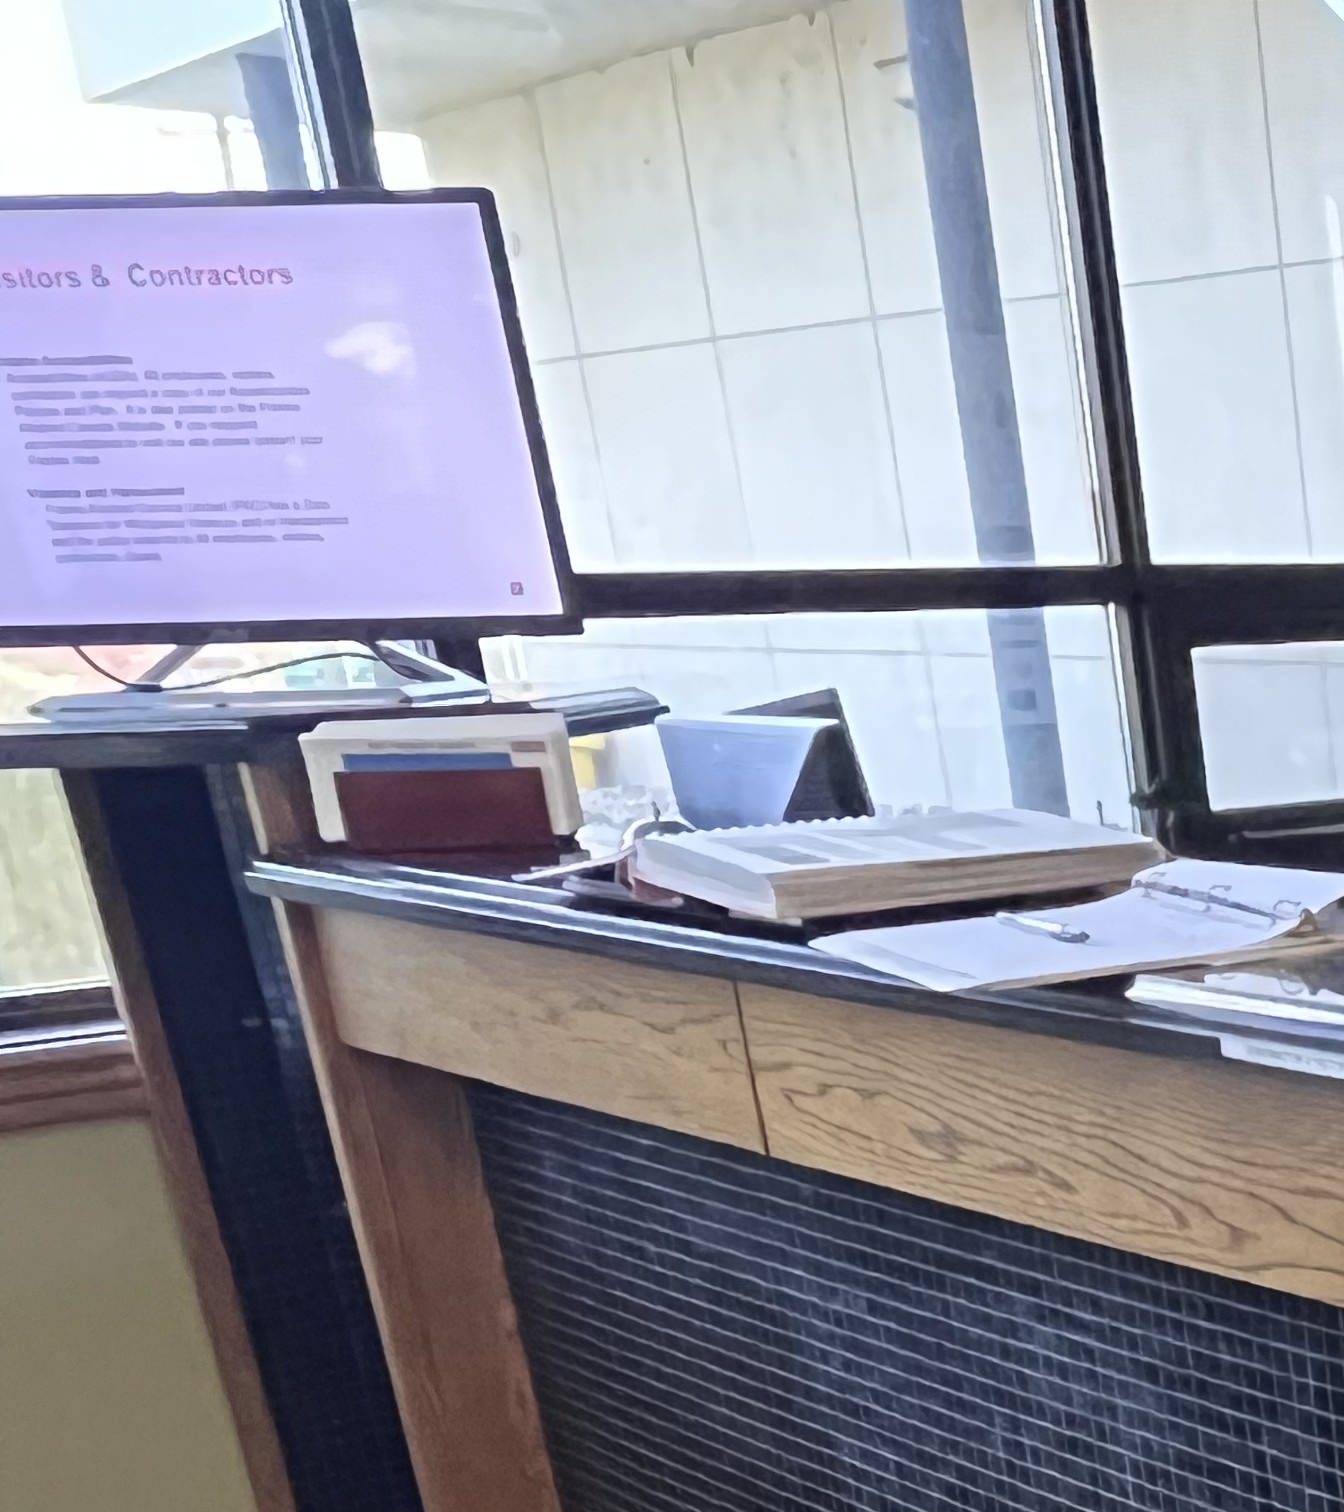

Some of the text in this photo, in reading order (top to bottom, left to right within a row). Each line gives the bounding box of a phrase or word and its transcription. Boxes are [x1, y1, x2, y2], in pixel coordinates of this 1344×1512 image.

[0, 262, 294, 289] sitors & Contractors
